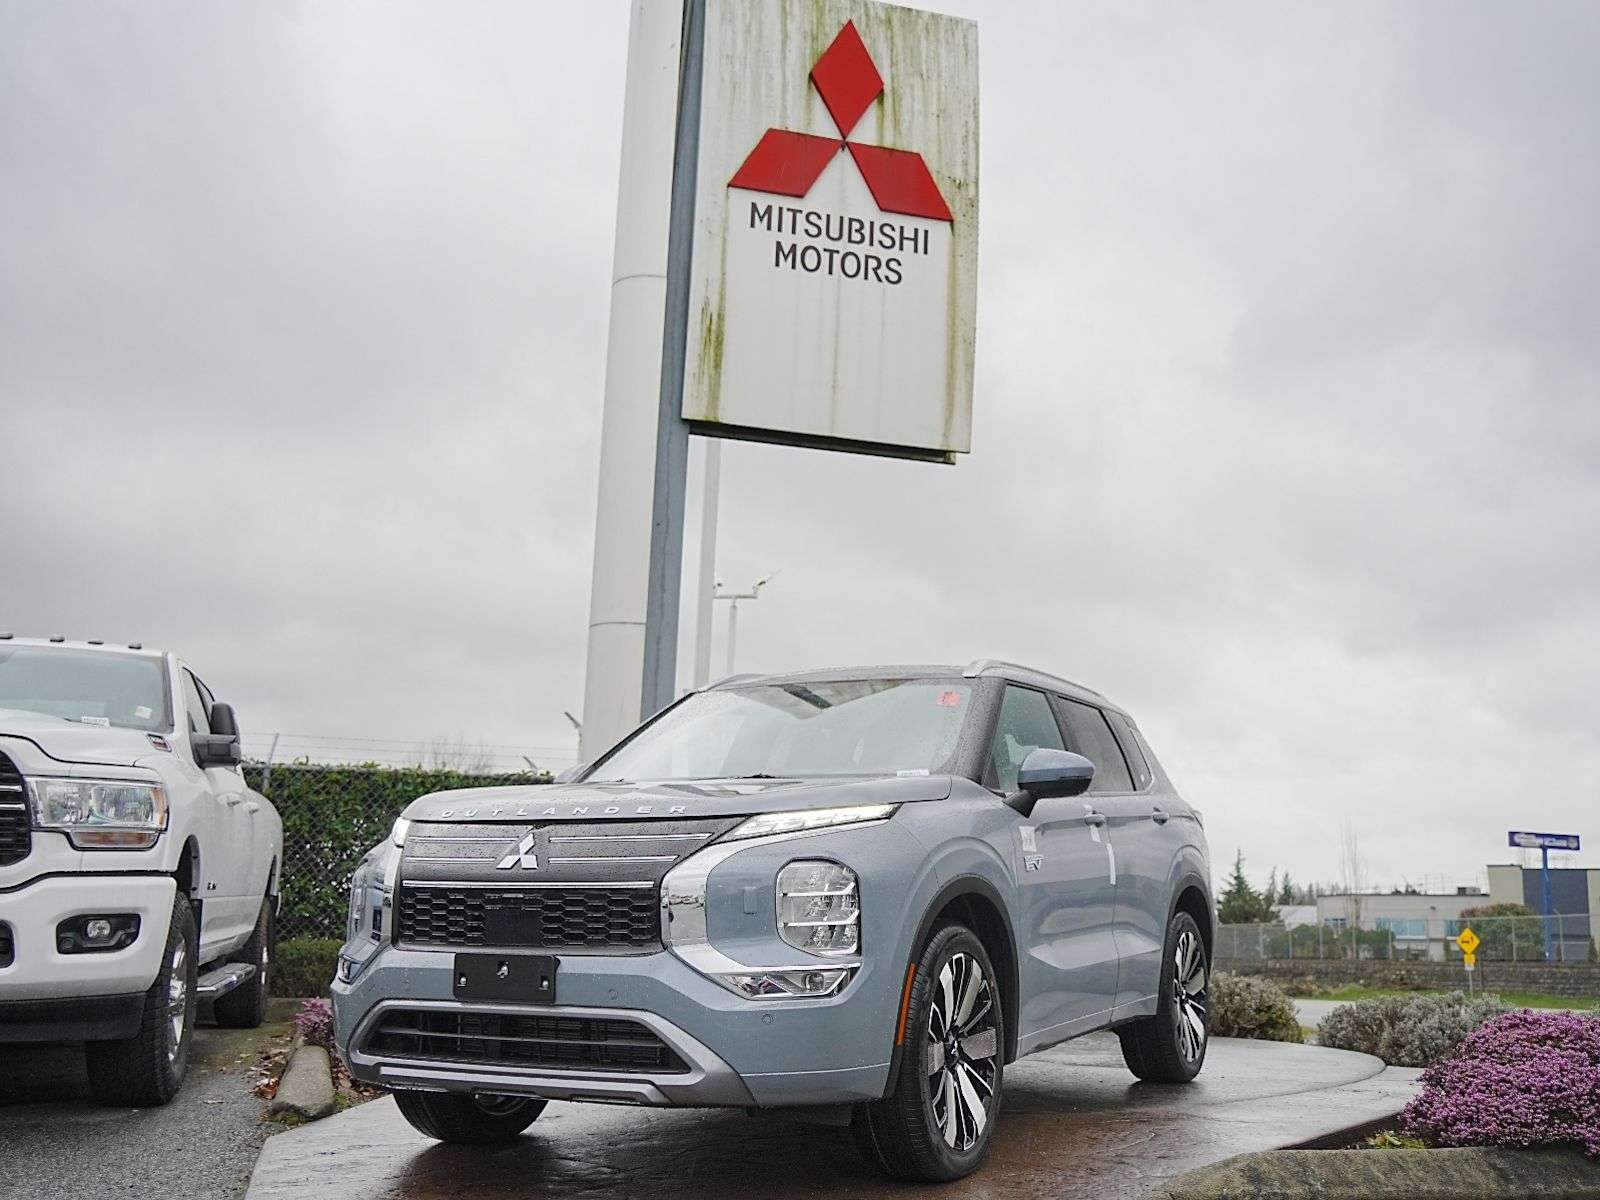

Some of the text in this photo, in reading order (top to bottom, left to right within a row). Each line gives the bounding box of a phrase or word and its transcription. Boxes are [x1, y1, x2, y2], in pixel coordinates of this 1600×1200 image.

[750, 202, 929, 255] MITSUBISHI
[774, 240, 902, 285] MOTORS
[440, 805, 688, 818] OUTLANDER
